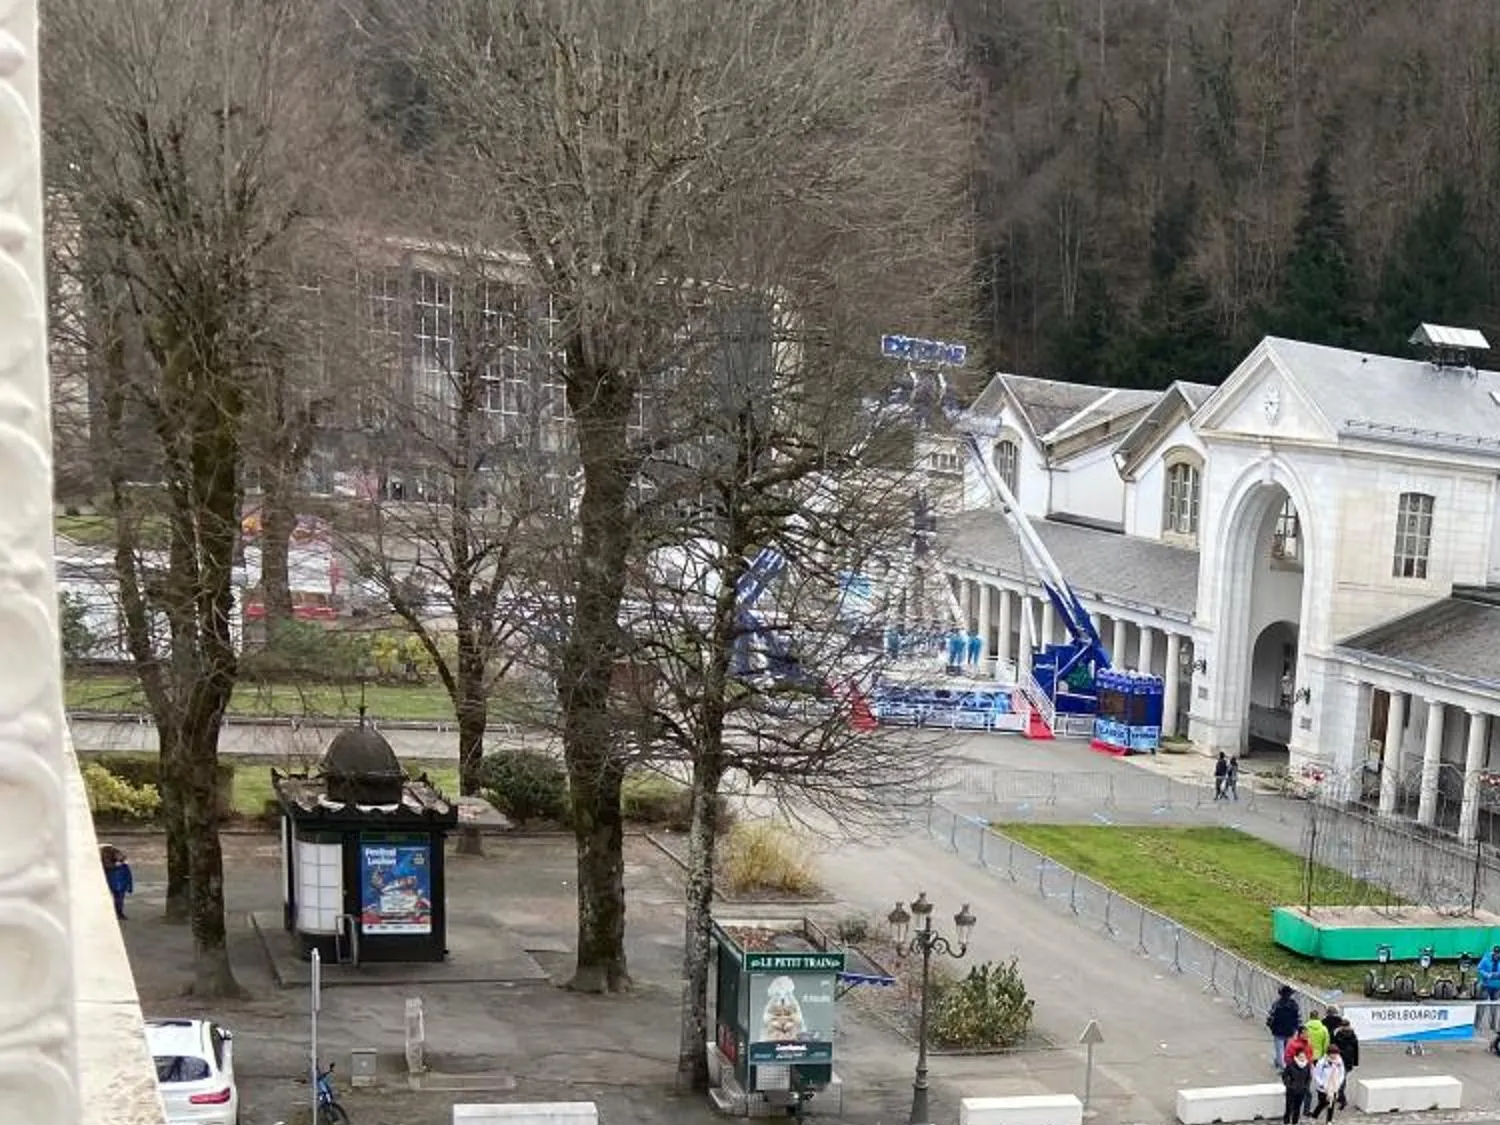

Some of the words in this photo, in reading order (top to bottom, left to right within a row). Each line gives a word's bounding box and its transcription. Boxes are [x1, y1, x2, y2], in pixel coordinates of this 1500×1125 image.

[761, 957, 771, 968] LE
[775, 957, 801, 968] PETIT
[804, 957, 831, 968] TRAIN
